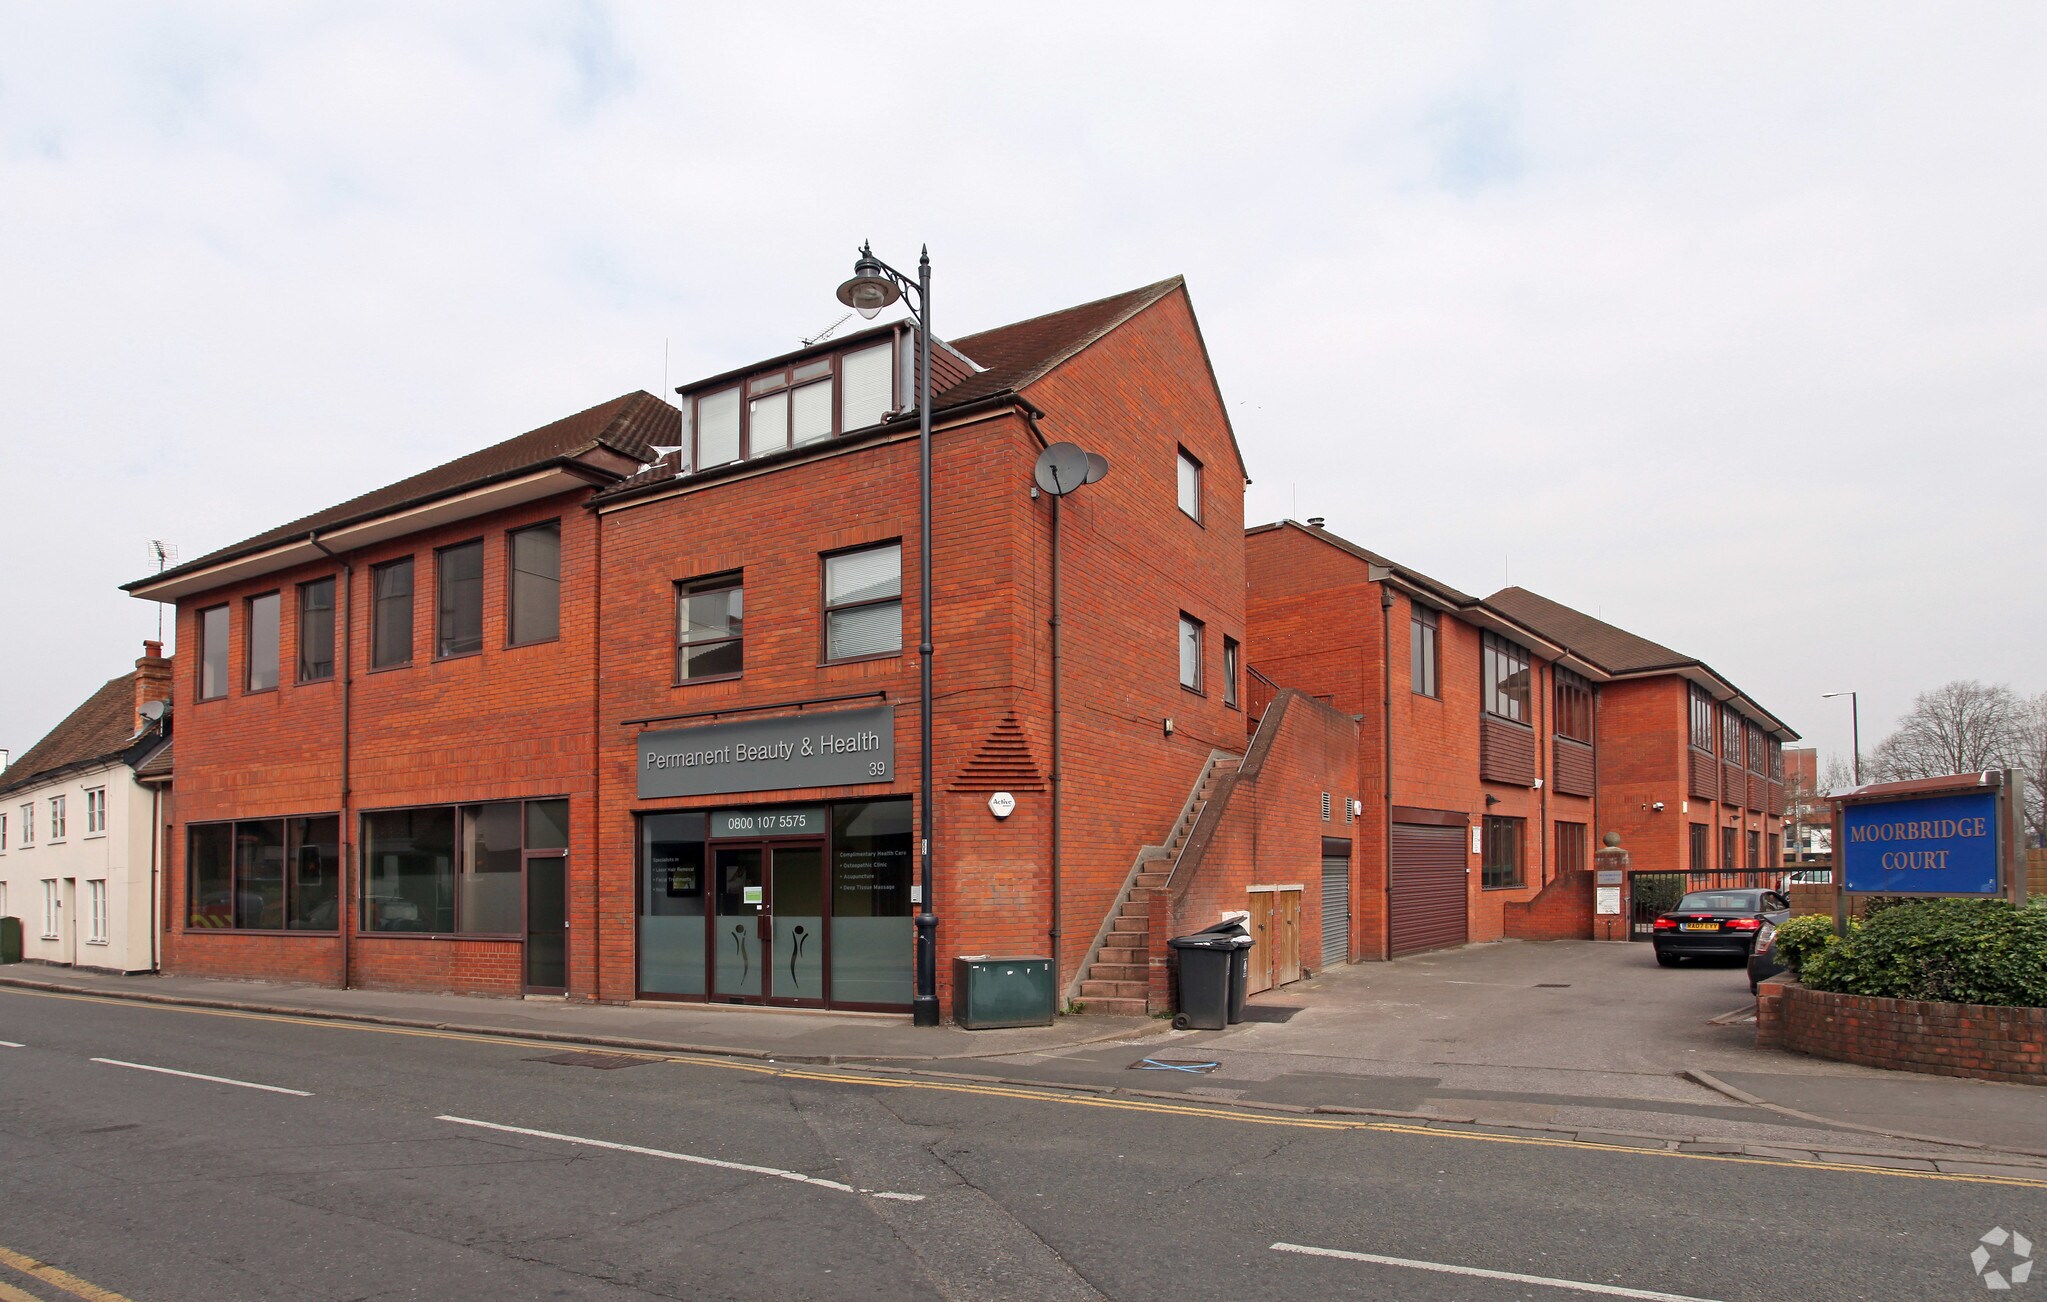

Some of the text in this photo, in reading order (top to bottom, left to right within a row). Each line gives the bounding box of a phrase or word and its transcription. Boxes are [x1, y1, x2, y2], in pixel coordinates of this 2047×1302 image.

[646, 730, 879, 770] Permanent Beauty & Health
[868, 761, 885, 776] 39
[728, 814, 806, 830] 0800 107 5575
[1850, 817, 1987, 843] MOORBRIDGE
[1881, 850, 1950, 870] COURT
